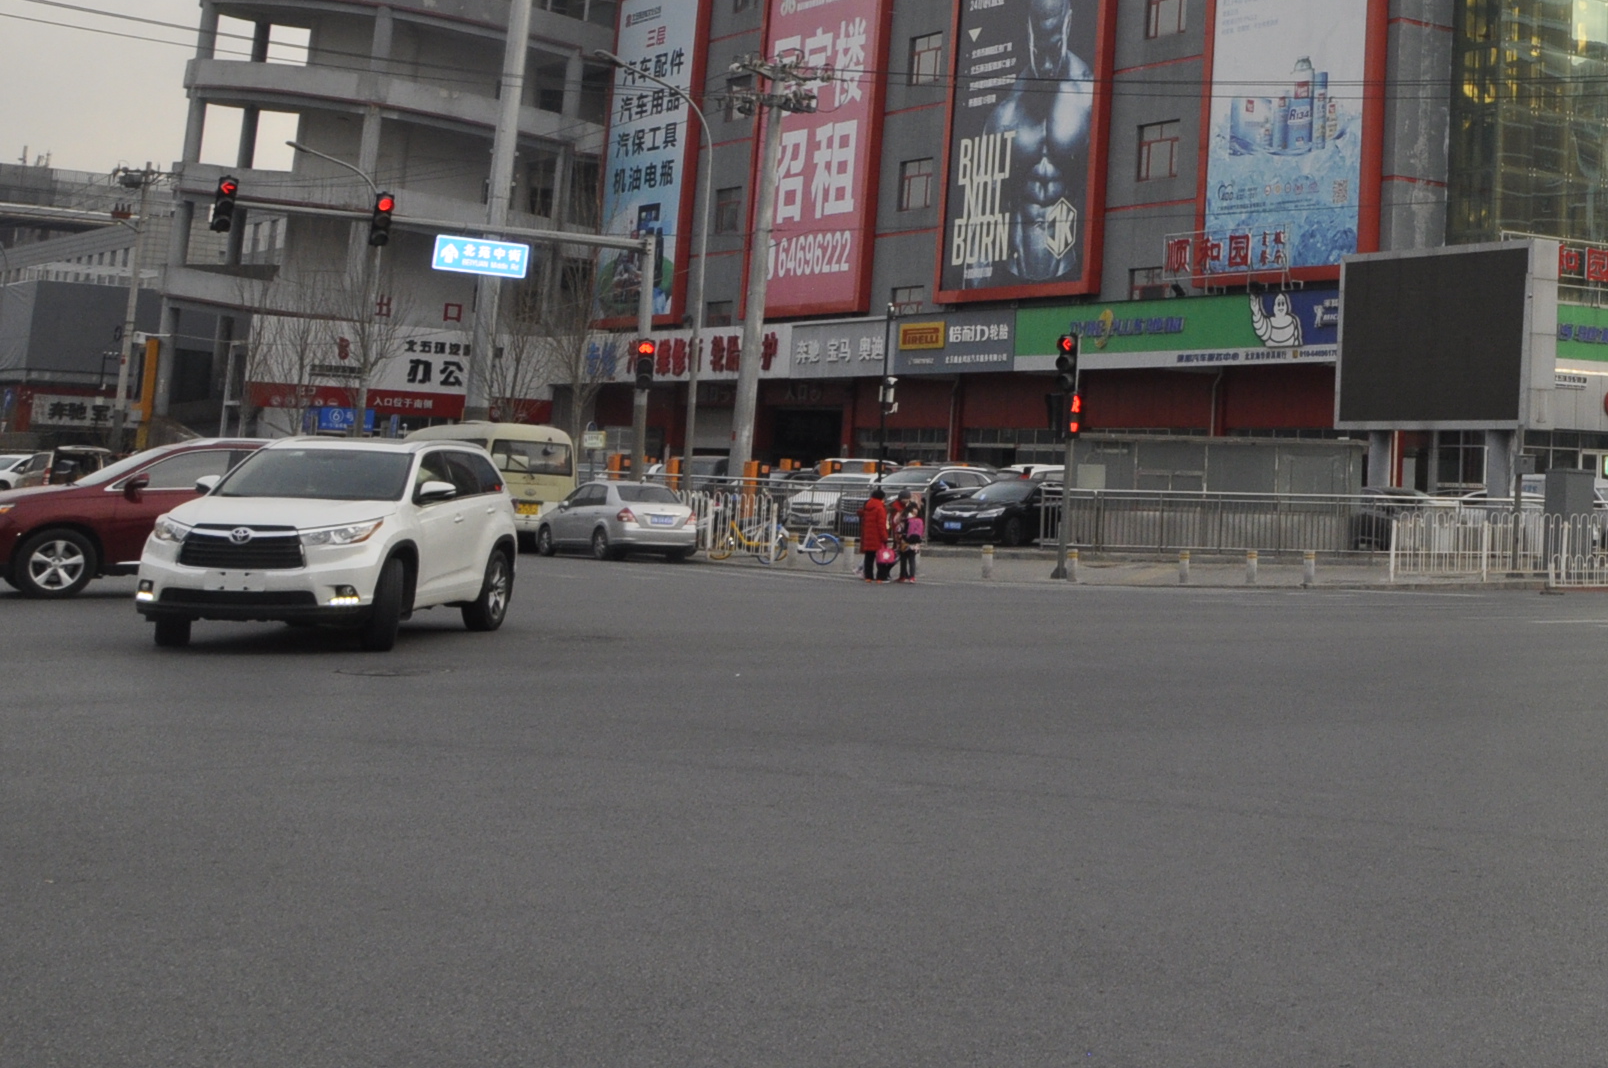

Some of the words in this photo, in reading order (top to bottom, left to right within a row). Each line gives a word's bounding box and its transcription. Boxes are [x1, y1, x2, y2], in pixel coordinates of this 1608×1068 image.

[646, 26, 666, 47] 三层
[623, 47, 684, 86] 汽车配件
[619, 85, 680, 122] 汽车用品
[616, 122, 677, 158] 汽保工具
[958, 130, 1017, 185] BUILT
[613, 159, 675, 193] 机油电瓶
[776, 119, 858, 224] 招租
[963, 173, 1005, 222] NOT
[463, 243, 522, 262] 北苑中街
[778, 231, 851, 277] 64696222
[796, 339, 820, 364] 奔驰
[826, 339, 851, 362] 宝马
[859, 336, 884, 361] 奥迪
[949, 323, 1008, 343] 倍耐力轮胎
[710, 332, 778, 372] 轮胎护
[408, 359, 464, 387] 办公
[374, 396, 433, 409] 入口位于南侧
